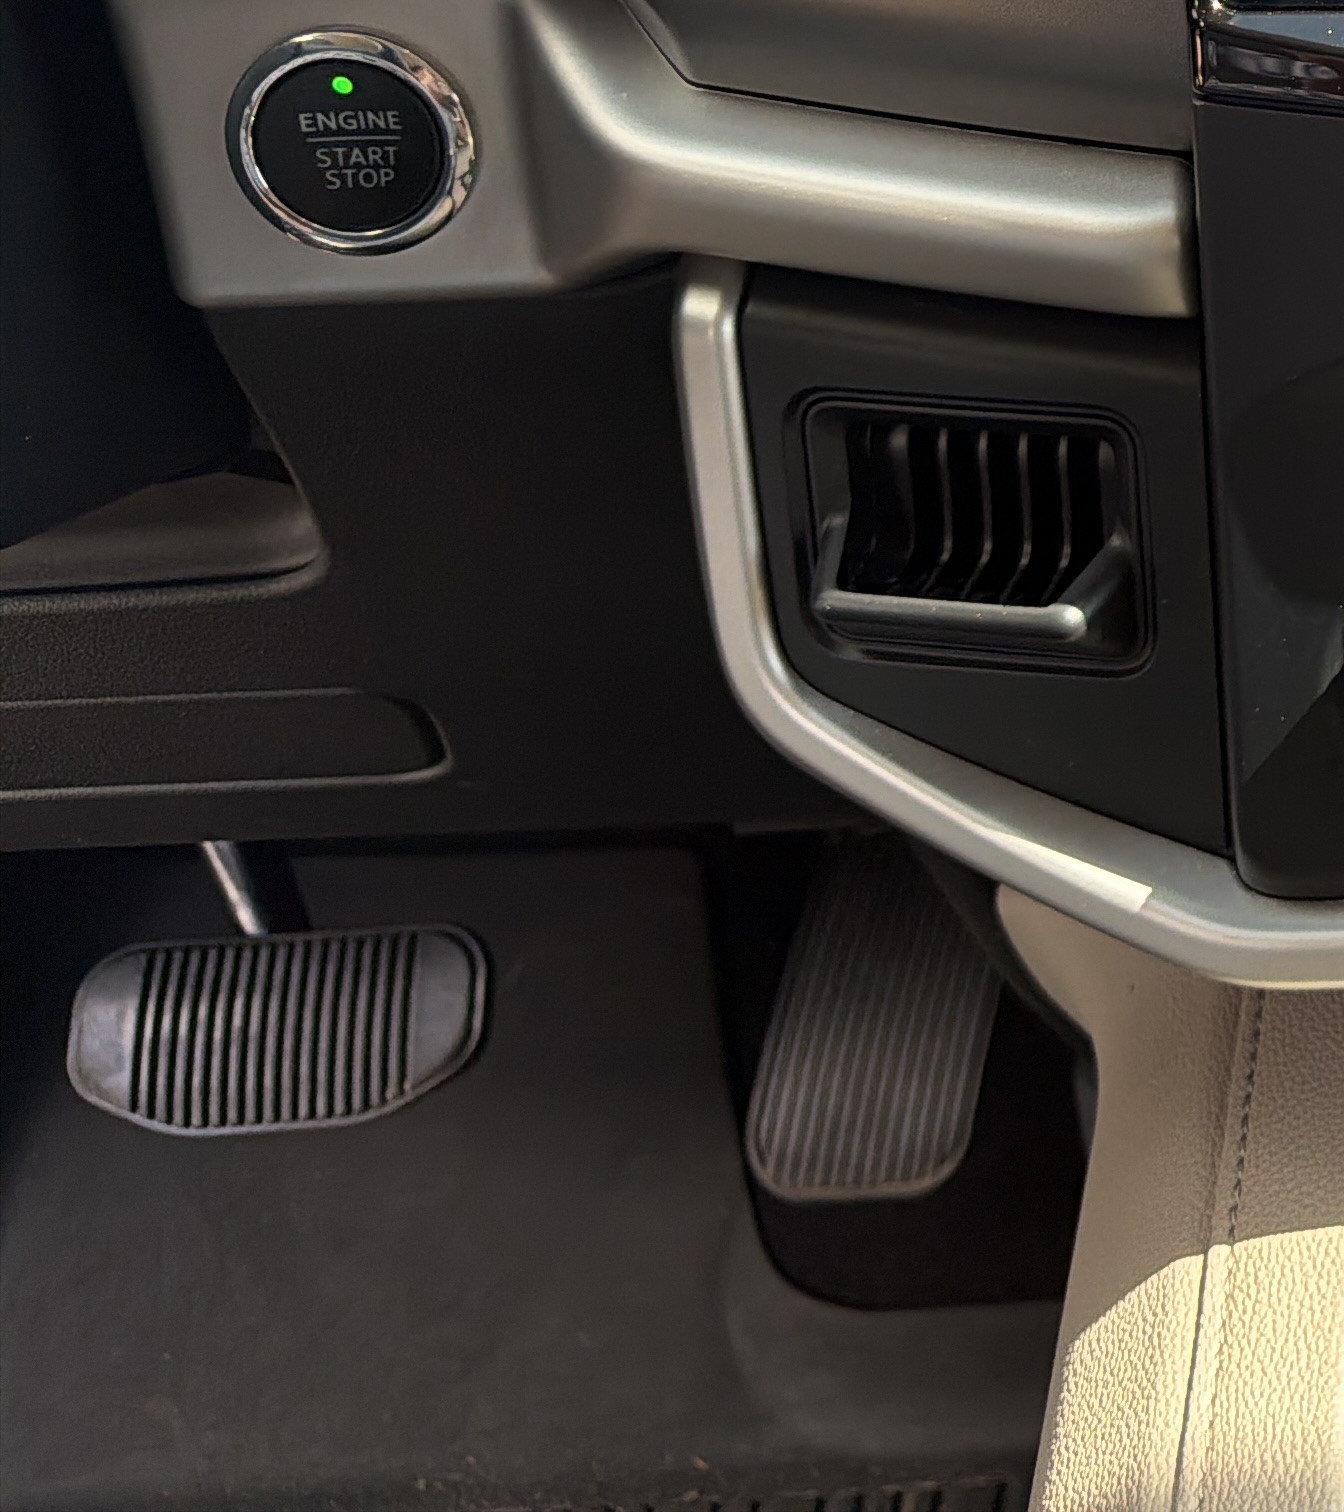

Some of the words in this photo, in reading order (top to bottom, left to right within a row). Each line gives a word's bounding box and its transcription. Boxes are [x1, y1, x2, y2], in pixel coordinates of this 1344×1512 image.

[298, 110, 402, 133] ENGINE
[315, 146, 397, 168] START
[325, 168, 395, 190] STOP
